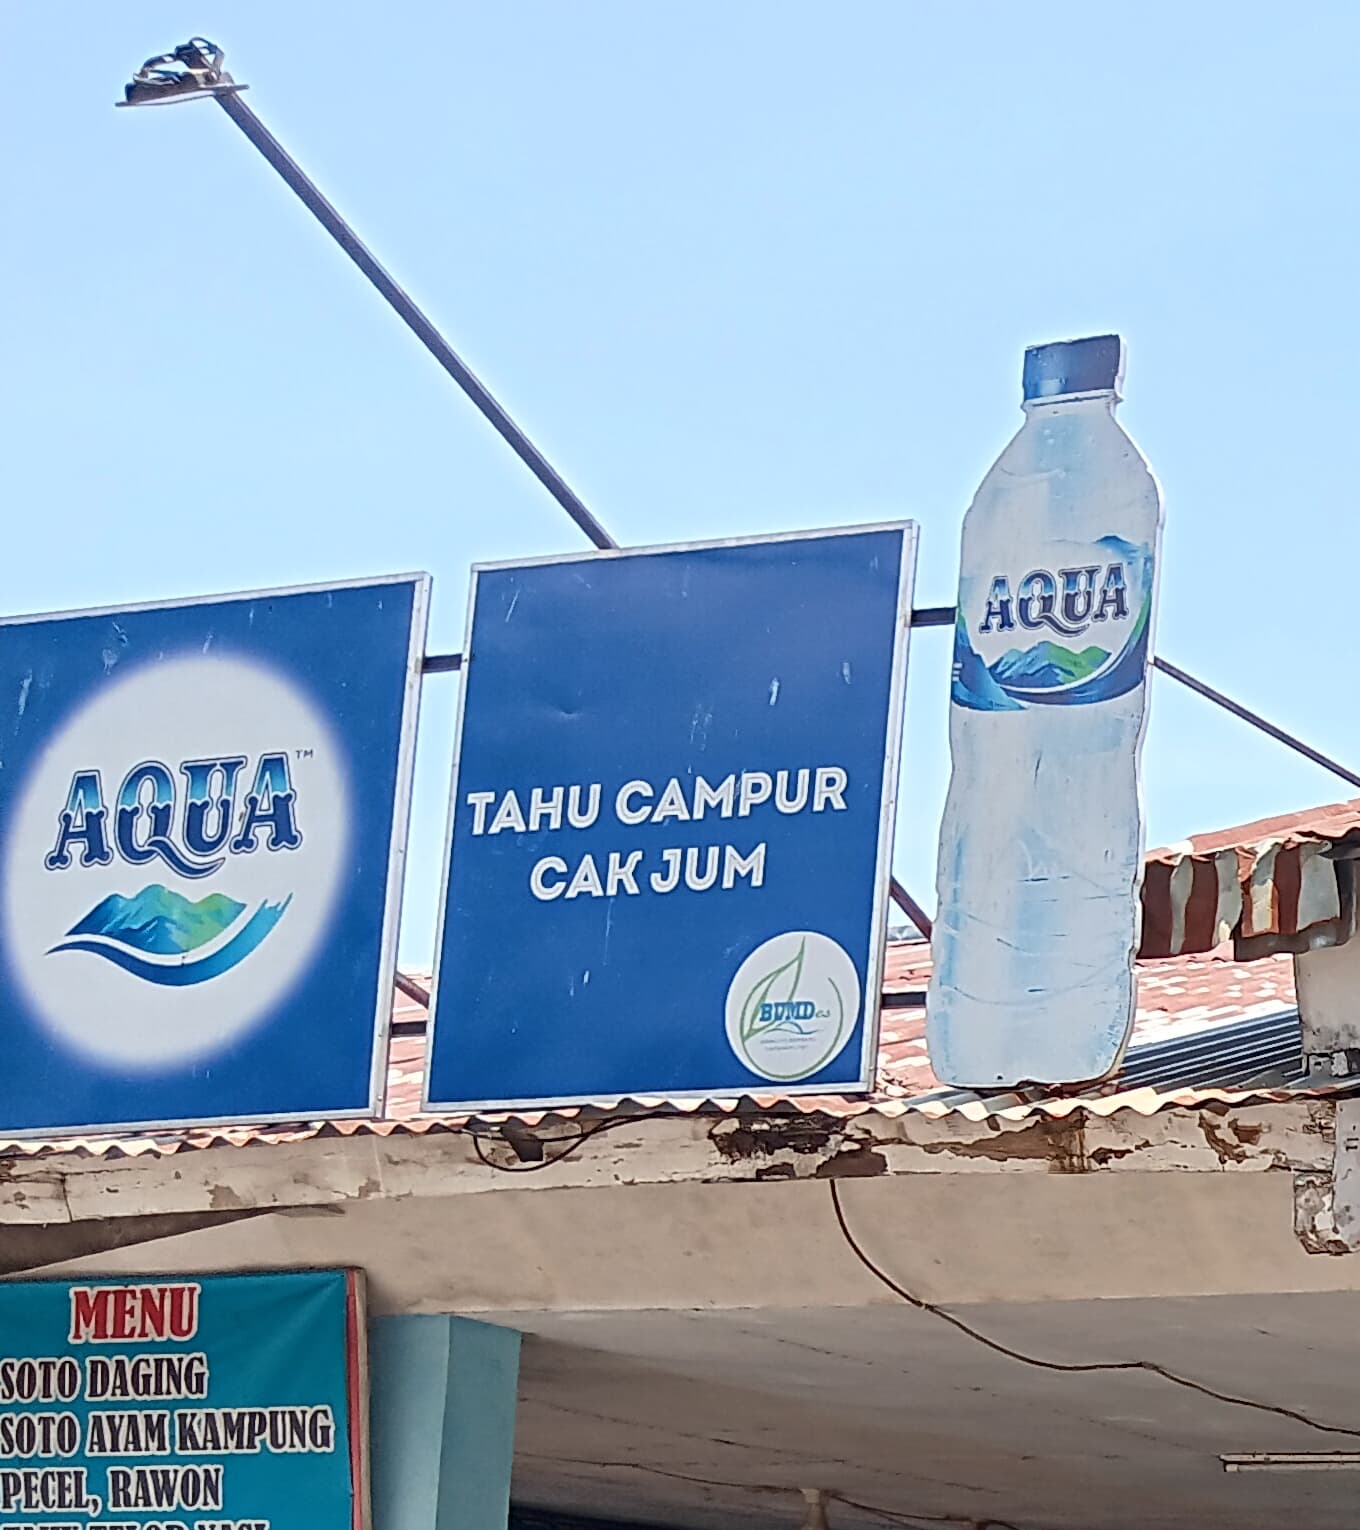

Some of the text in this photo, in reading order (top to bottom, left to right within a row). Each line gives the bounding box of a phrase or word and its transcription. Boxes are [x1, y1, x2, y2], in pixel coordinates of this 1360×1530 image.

[979, 562, 1130, 638] AQUA
[44, 752, 304, 879] AQUA
[467, 766, 849, 836] TAHU CAMPUR
[530, 842, 767, 901] CAK JUM
[70, 1285, 198, 1342] MENU
[1, 1355, 207, 1400] SOTO DAGING
[1, 1408, 333, 1456] SOTO AYAM KAMPUNG
[1, 1467, 222, 1515] PECEL, RAWON
